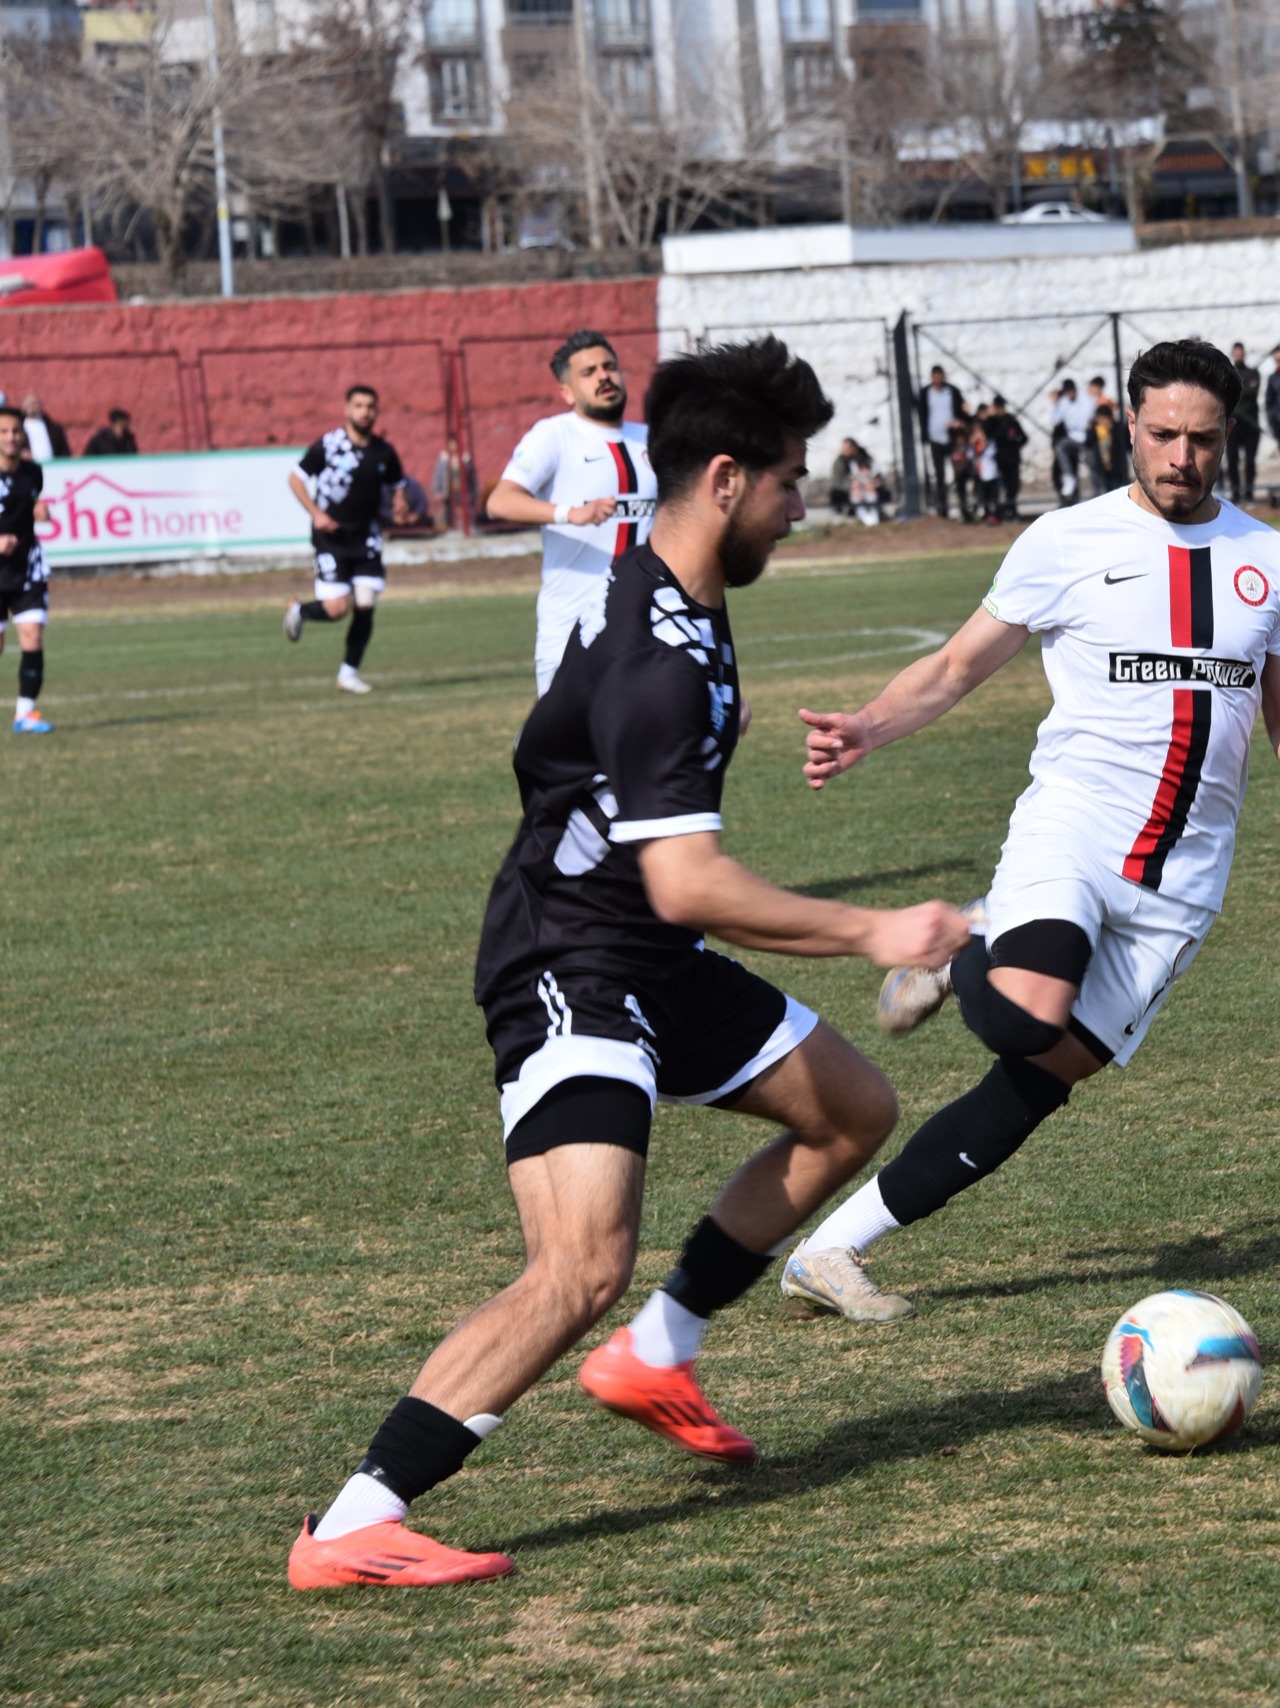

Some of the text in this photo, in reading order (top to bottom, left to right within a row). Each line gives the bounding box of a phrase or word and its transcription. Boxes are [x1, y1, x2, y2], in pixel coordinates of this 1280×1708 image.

[36, 496, 243, 541] She home
[1115, 655, 1254, 686] Green Power
